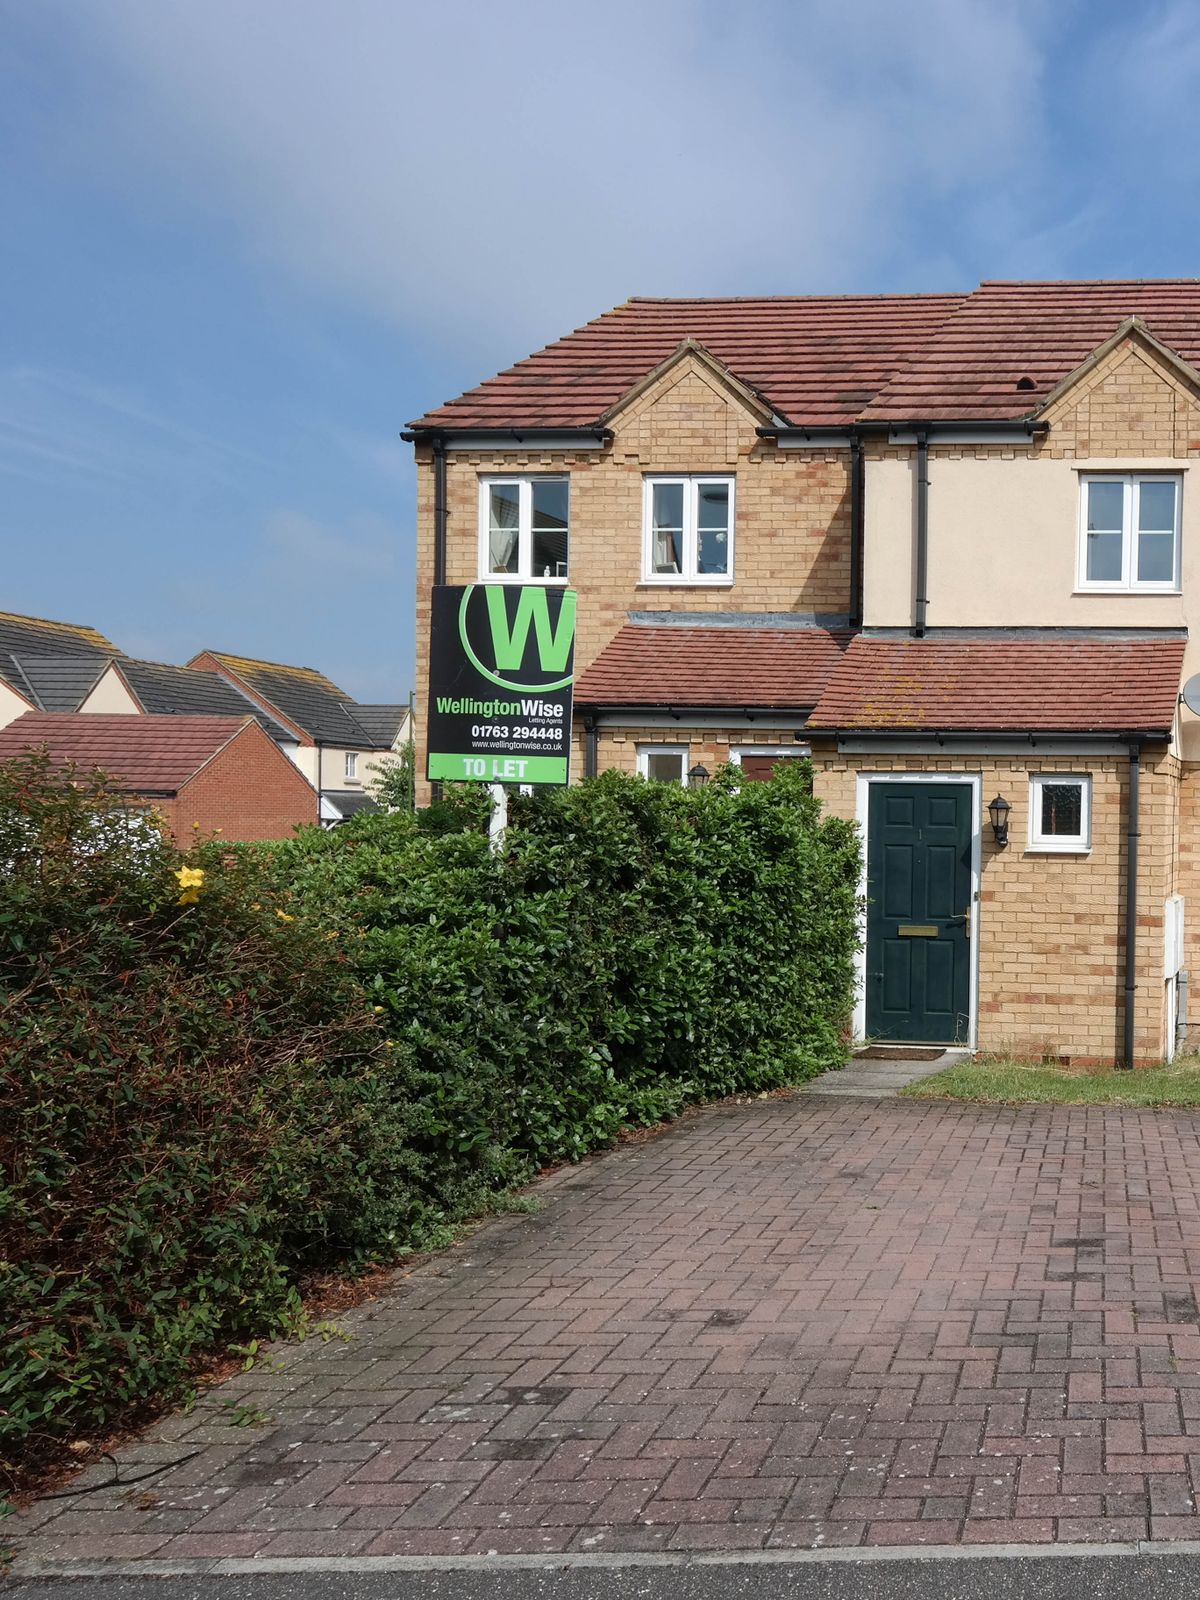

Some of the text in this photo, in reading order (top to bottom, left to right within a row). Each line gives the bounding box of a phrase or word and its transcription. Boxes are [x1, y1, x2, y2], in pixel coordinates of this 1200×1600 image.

[485, 585, 577, 672] W
[436, 697, 564, 718] WellingtonWise
[471, 725, 563, 740] 01763 294448
[471, 740, 563, 751] www.wellingtonwise.co.uk
[463, 758, 528, 778] TO LET
